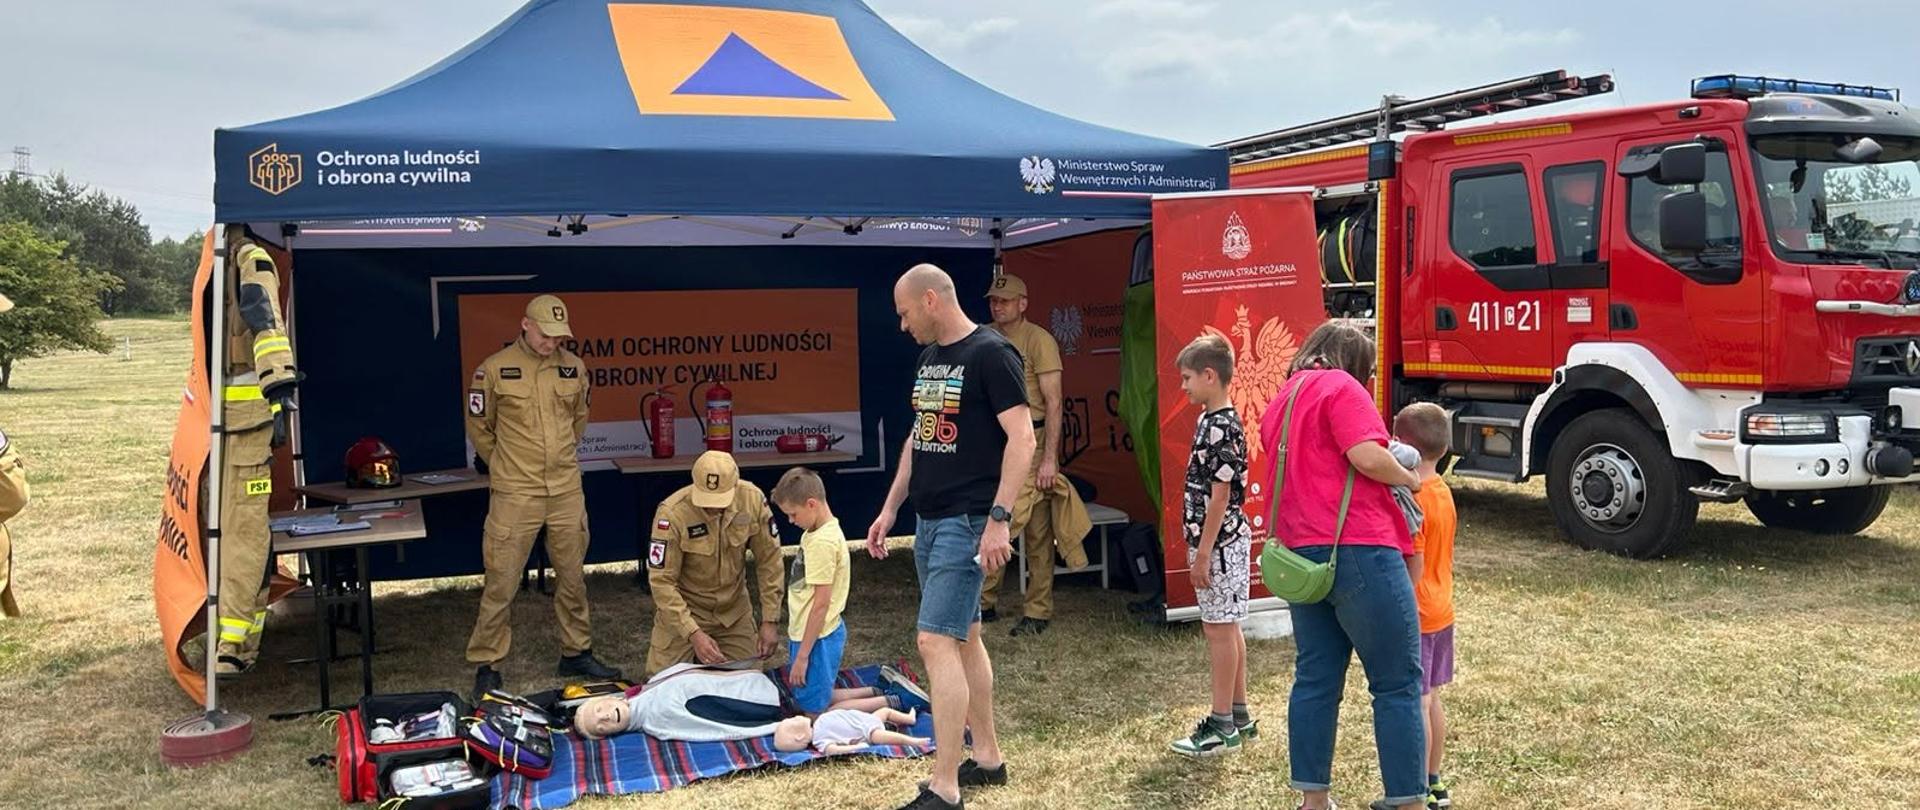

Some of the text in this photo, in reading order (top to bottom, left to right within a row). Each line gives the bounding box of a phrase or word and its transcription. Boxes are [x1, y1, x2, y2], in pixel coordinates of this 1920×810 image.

[317, 149, 480, 166] Ochrona ludności
[1058, 159, 1165, 173] Ministerstwo Spraw
[318, 167, 471, 186] i obrona cywilna
[1060, 173, 1216, 190] Wewnętrznych i Administracji
[1182, 263, 1297, 281] PAŃSTWOWA STRAŻ POŻARNA
[1468, 301, 1500, 332] 411
[1517, 300, 1541, 331] 21
[622, 335, 724, 357] OCHRONY
[732, 329, 832, 353] LUDNOŚCI
[674, 361, 778, 384] CYWILNEJ
[918, 364, 965, 380] ORIGINAL
[739, 423, 831, 438] Ochrona ludności
[582, 435, 607, 445] Spraw
[745, 437, 776, 449] obron
[922, 441, 957, 453] EDITION
[250, 482, 269, 492] PSP
